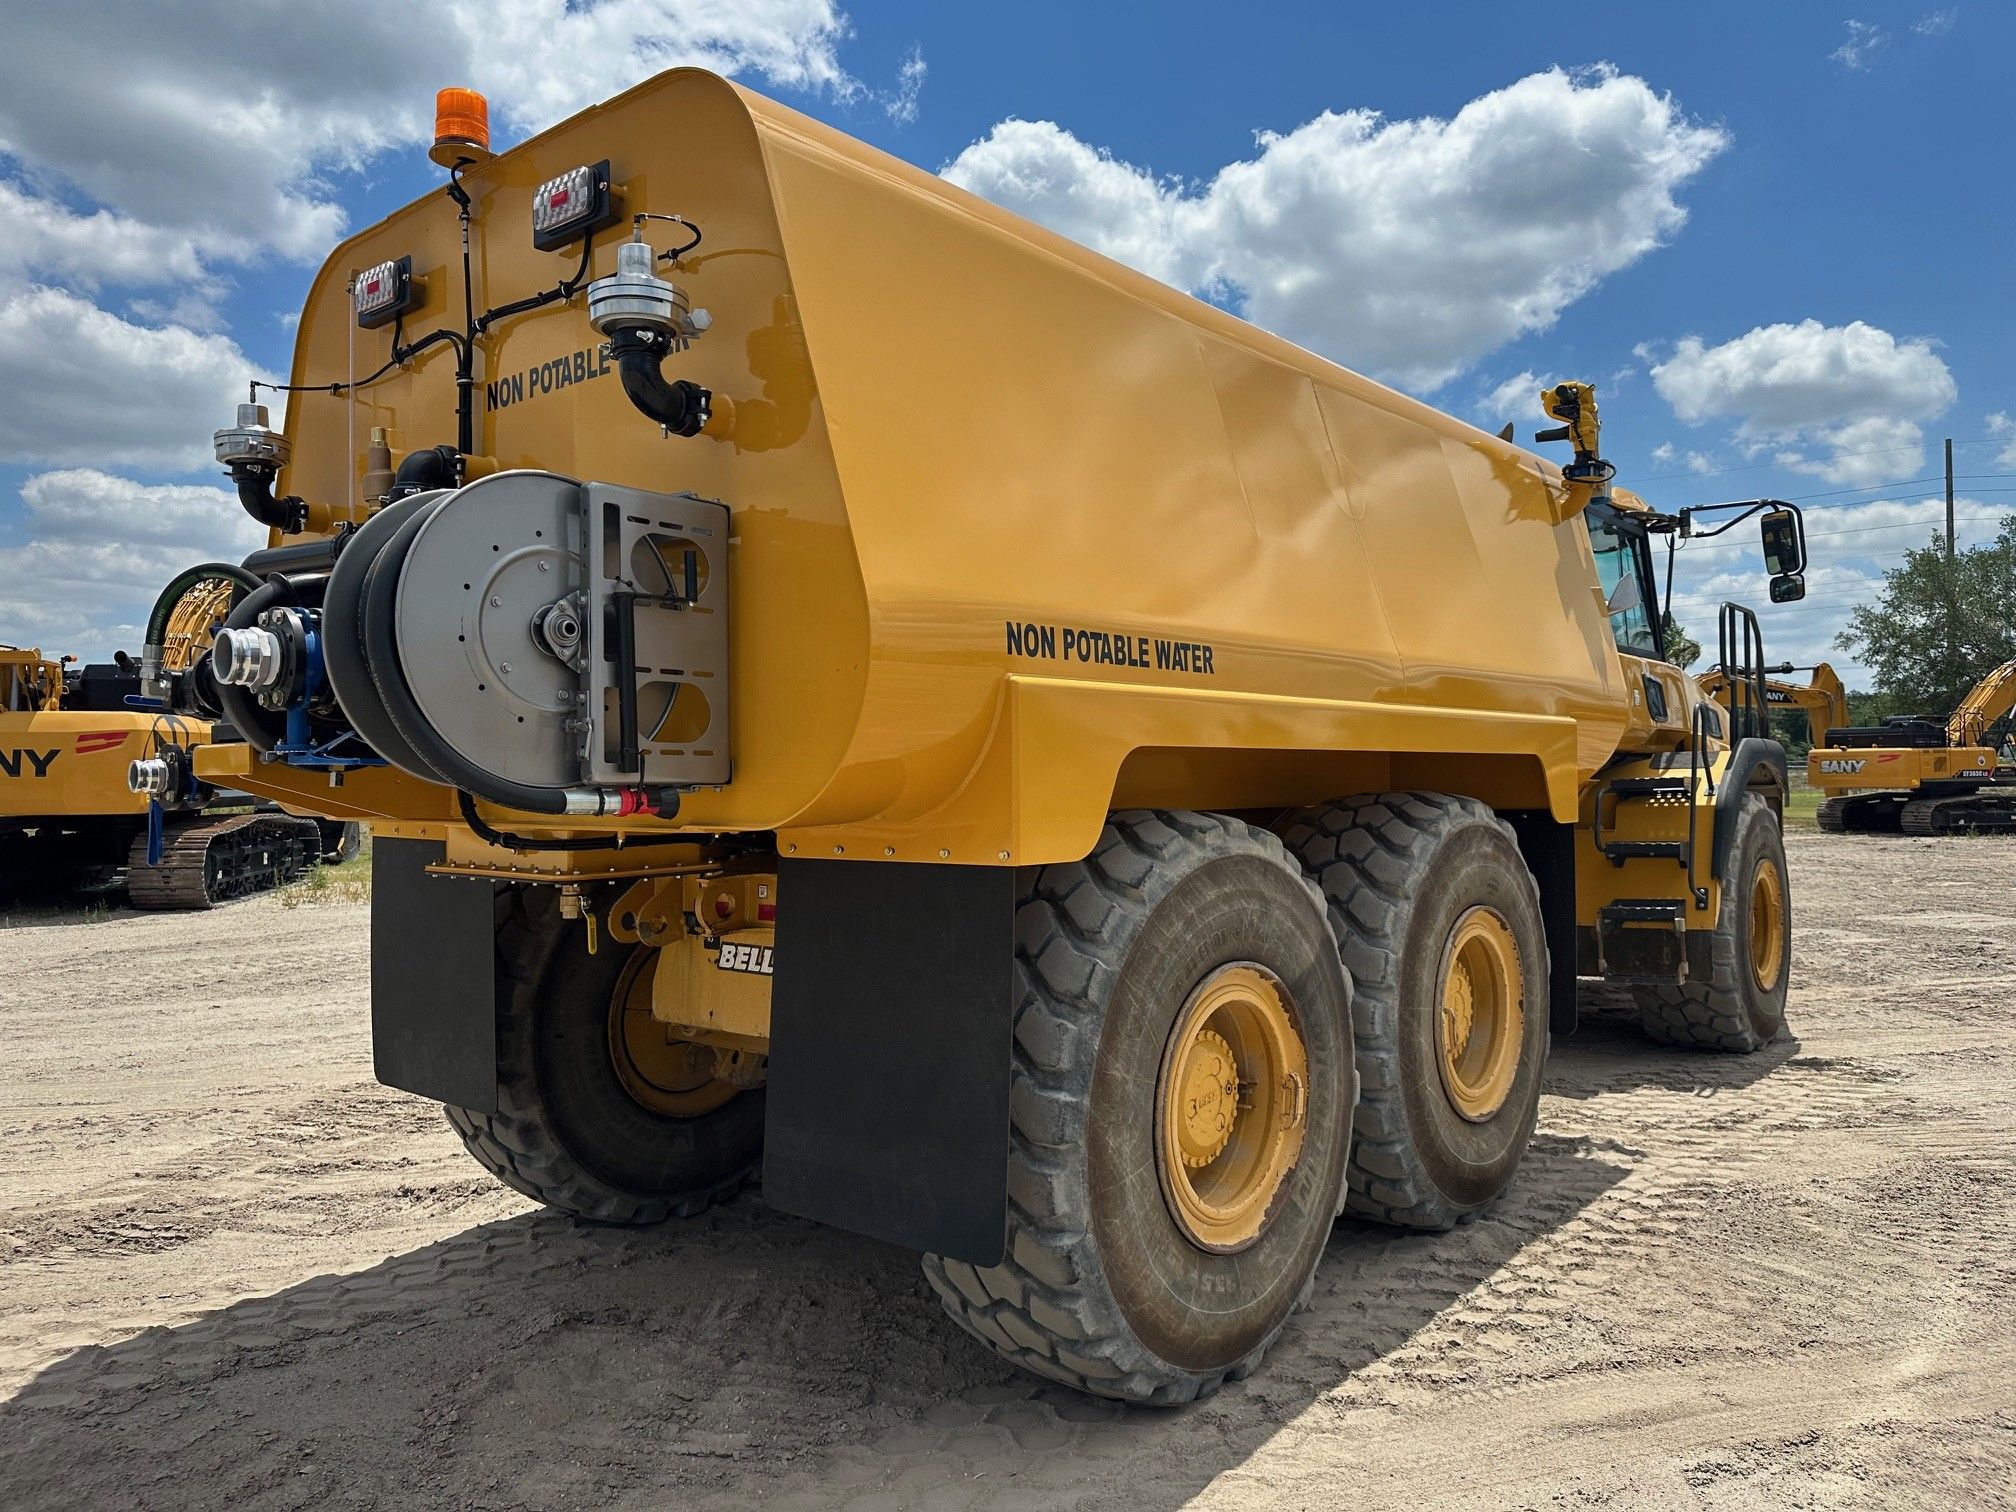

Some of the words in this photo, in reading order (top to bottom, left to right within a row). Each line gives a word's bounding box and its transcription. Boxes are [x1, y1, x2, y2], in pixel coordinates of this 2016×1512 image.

[487, 372, 523, 412] NON
[529, 347, 611, 398] POTABLE
[1006, 621, 1056, 660] NON
[1063, 628, 1150, 668] POTABLE
[1154, 639, 1215, 674] WATER
[1766, 692, 1785, 701] ANY
[1820, 759, 1866, 774] SANY
[719, 944, 774, 973] BELL
